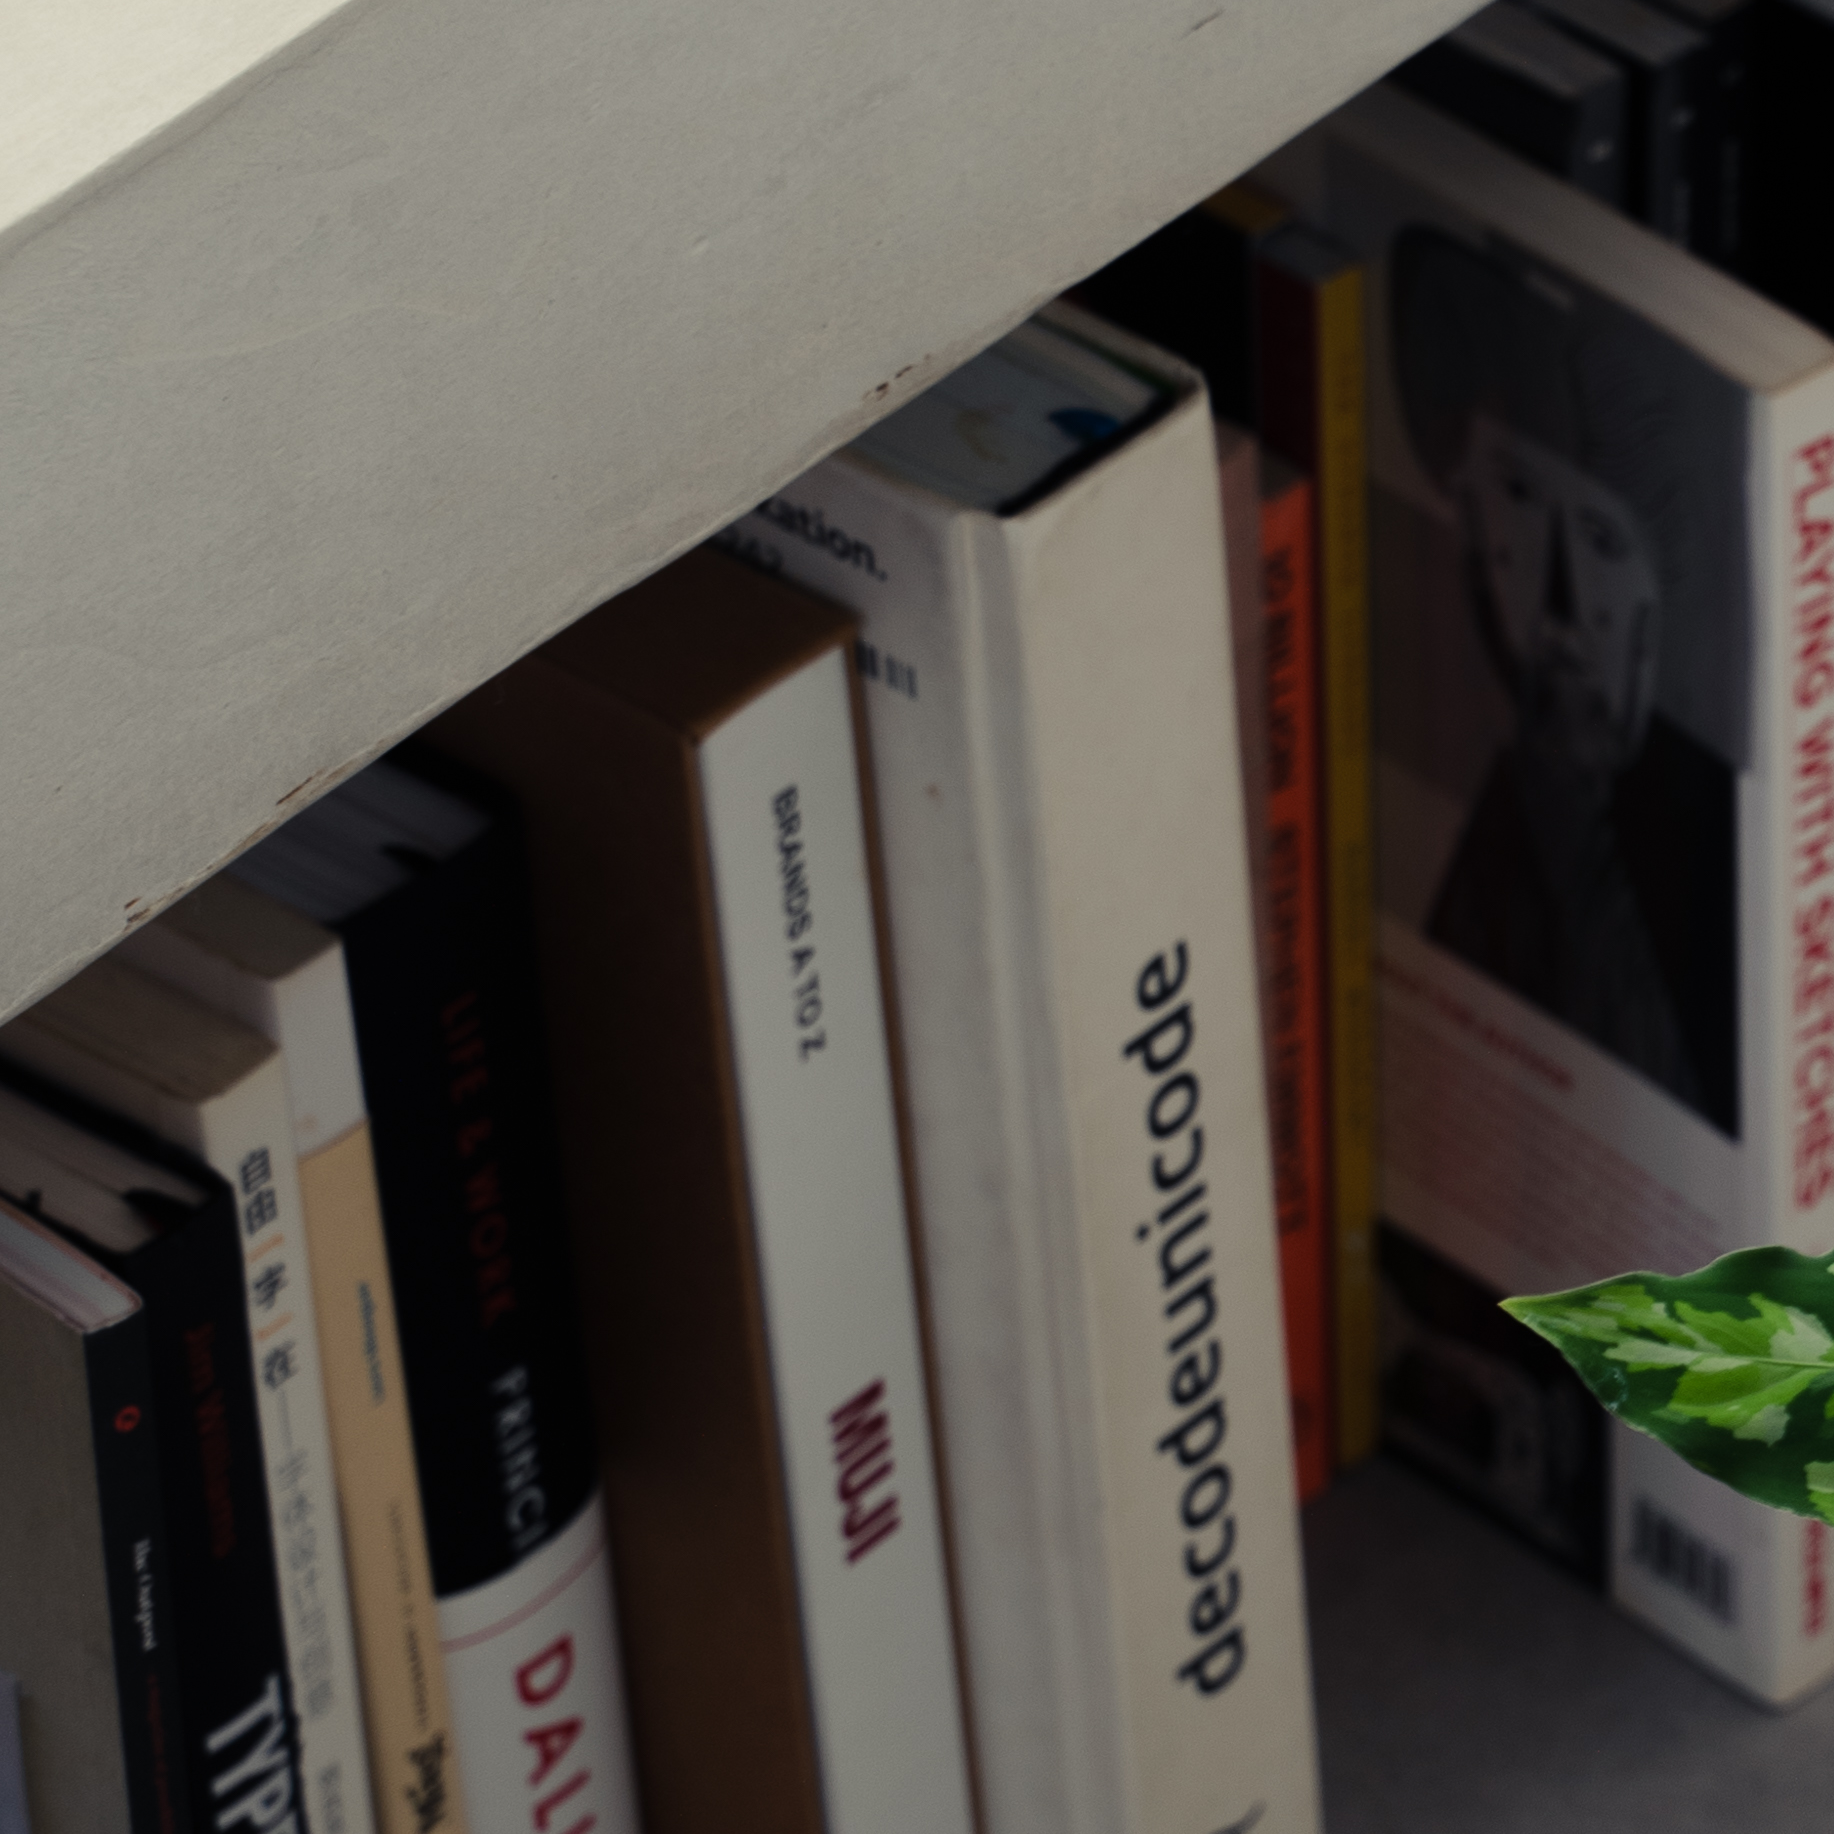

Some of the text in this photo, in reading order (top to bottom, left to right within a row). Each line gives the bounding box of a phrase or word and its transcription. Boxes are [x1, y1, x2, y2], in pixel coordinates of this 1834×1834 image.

[771, 783, 827, 1062] BRANDS A TO Z
[440, 990, 490, 1101] LIFE
[462, 1161, 517, 1331] WORK
[1122, 941, 1246, 1697] decodeunicode
[487, 1361, 550, 1554] PRINCI
[829, 1377, 902, 1569] MUJI
